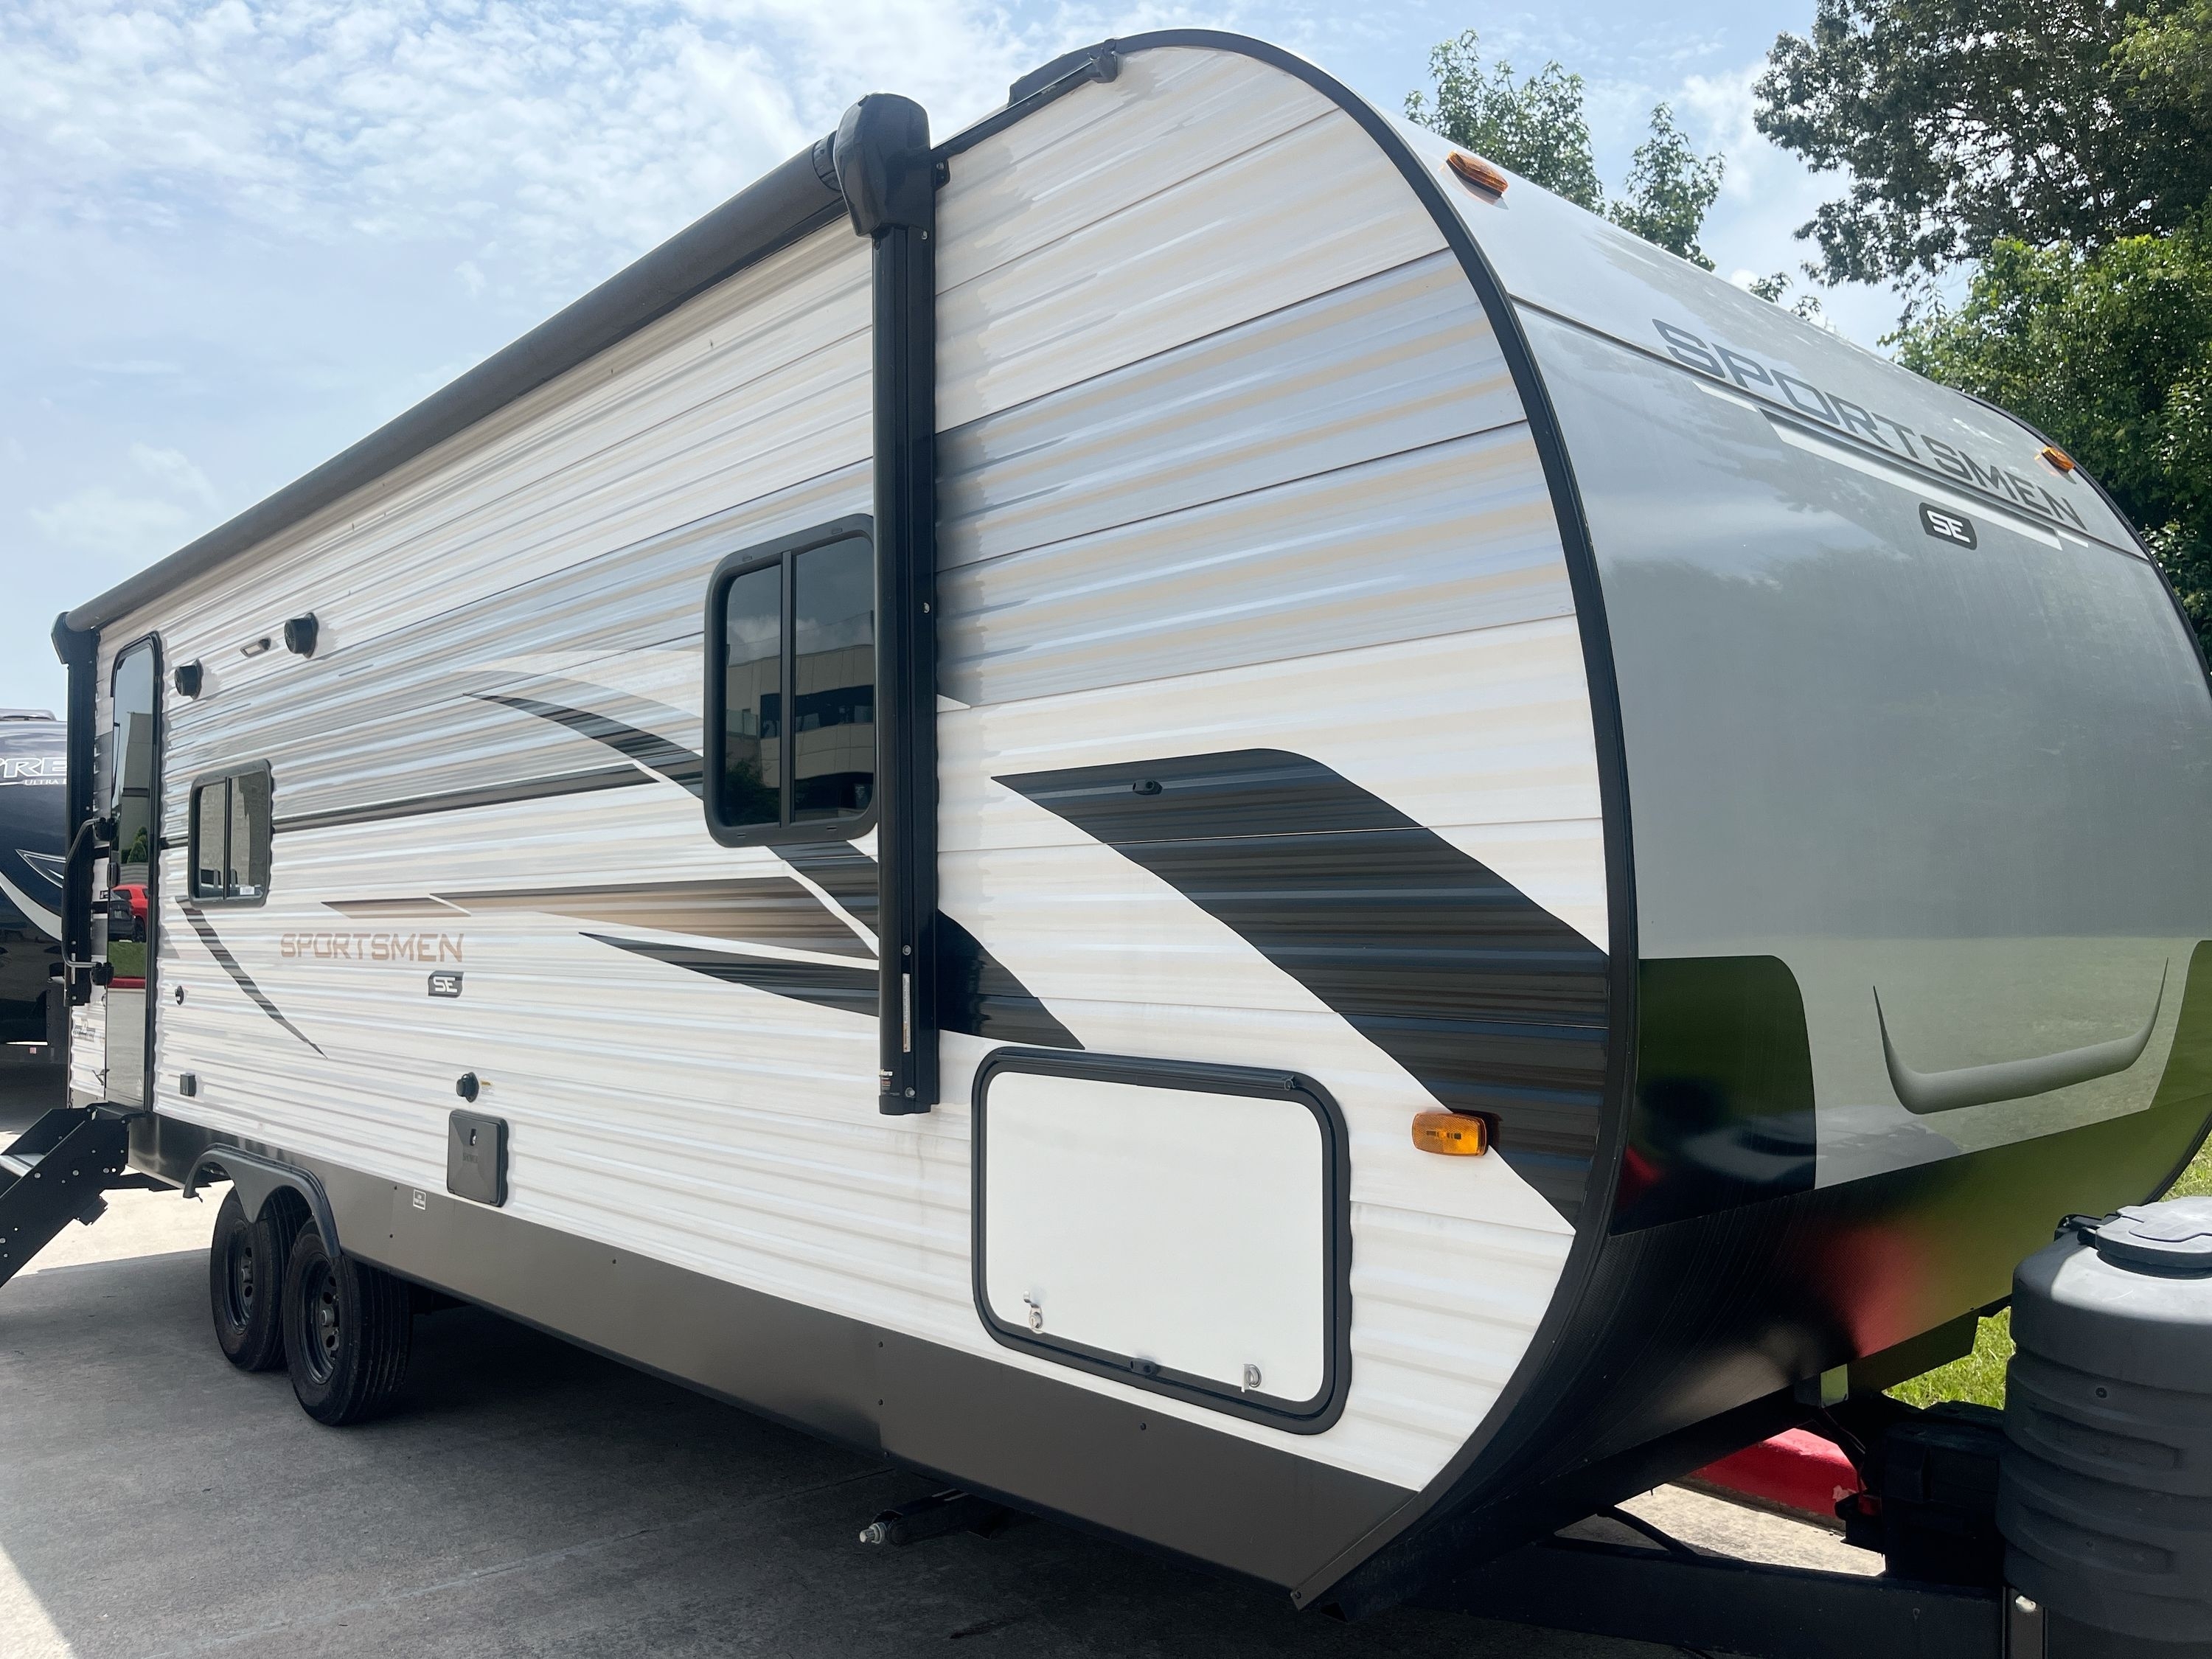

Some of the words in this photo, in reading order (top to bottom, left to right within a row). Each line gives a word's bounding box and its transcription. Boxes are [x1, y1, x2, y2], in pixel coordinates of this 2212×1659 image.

[1652, 319, 2087, 531] SPORTSMEN
[1927, 510, 1971, 543] SE
[281, 933, 464, 962] SPORTSMEN
[434, 977, 458, 993] SE
